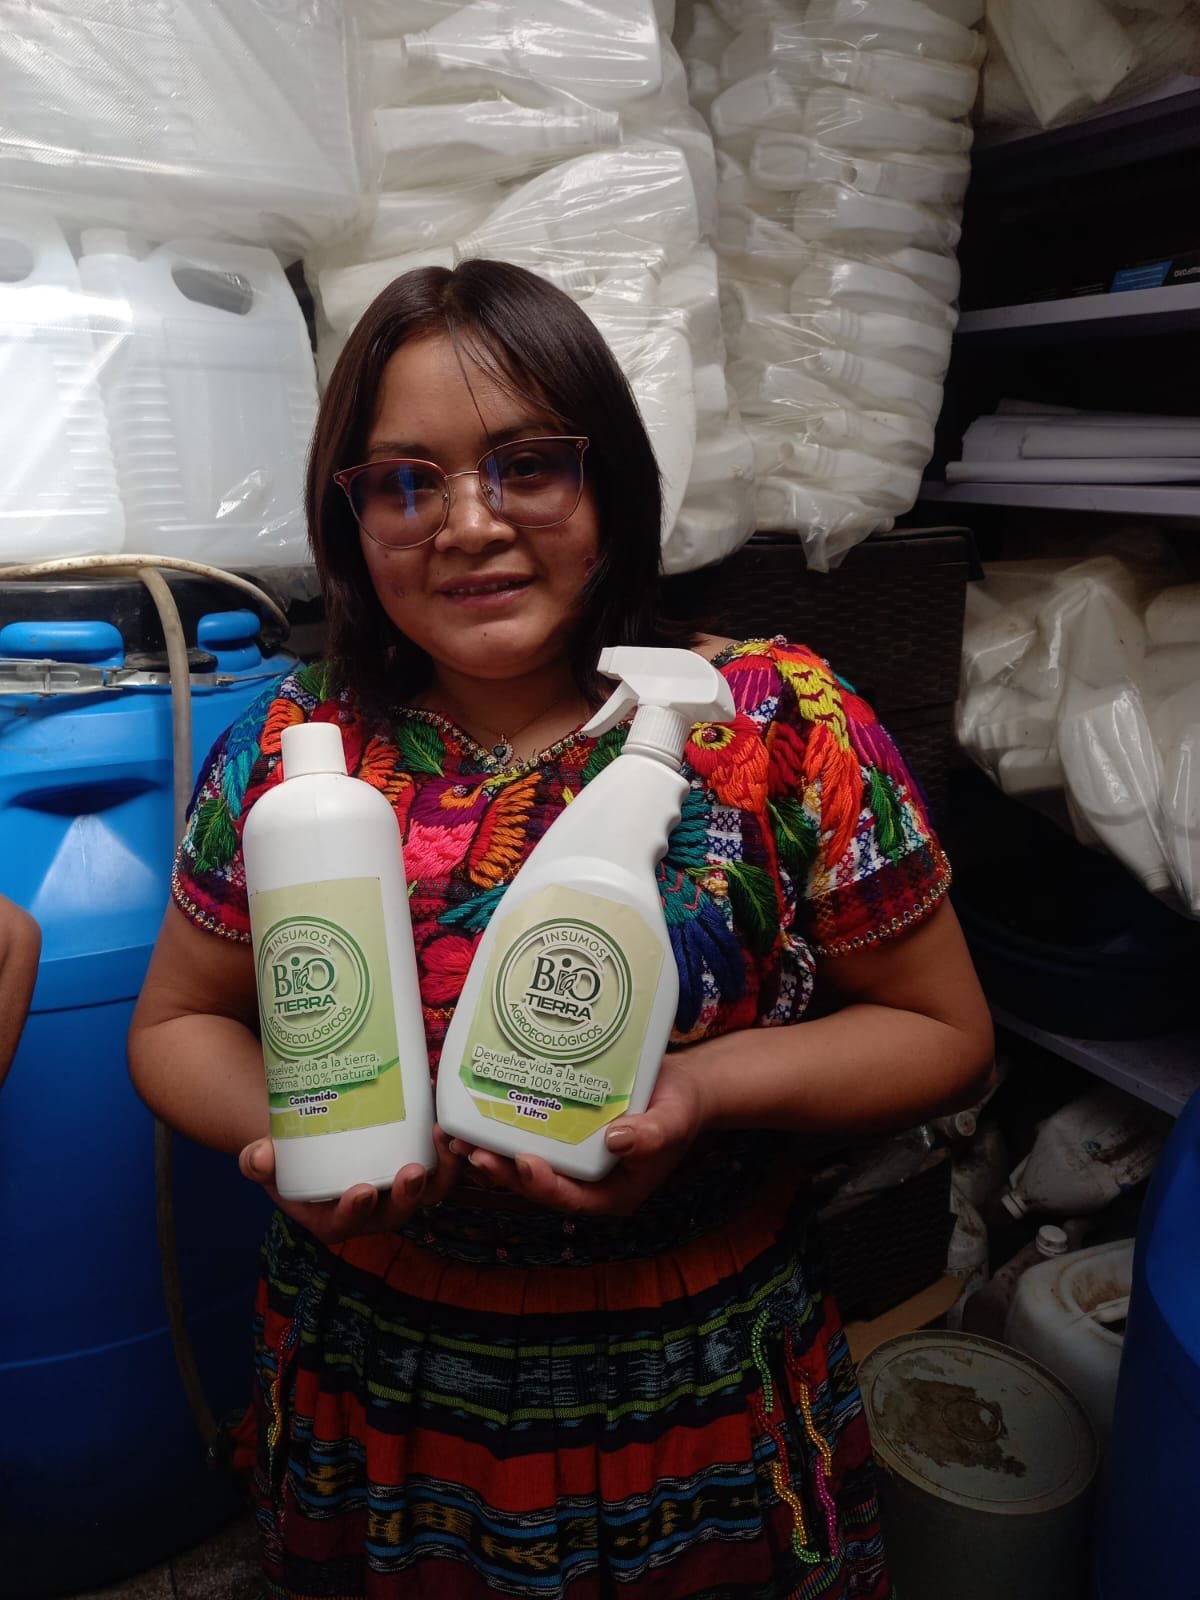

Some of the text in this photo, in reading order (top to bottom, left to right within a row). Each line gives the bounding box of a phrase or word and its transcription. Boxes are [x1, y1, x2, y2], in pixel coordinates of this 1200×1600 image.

[270, 929, 329, 955] INSUMOS
[545, 930, 607, 958] INSUMOS
[274, 994, 336, 1014] TIERRA
[525, 992, 591, 1020] TIERRA
[268, 1005, 352, 1044] AGROECOLÓGICOS
[509, 1002, 603, 1047] AGROECOLÓGICOS
[296, 1058, 318, 1072] vida
[321, 1061, 328, 1070] a
[331, 1056, 341, 1067] la
[474, 1046, 612, 1091] Devuelve vida a la tierra,
[275, 1077, 299, 1090] forma
[334, 1065, 376, 1082] natural
[475, 1063, 605, 1103] de forma 100% natural
[289, 1091, 338, 1105] Contenido
[299, 1105, 328, 1116] 1 Litro
[508, 1090, 562, 1111] Contenido
[516, 1105, 548, 1120] 1 Litro
